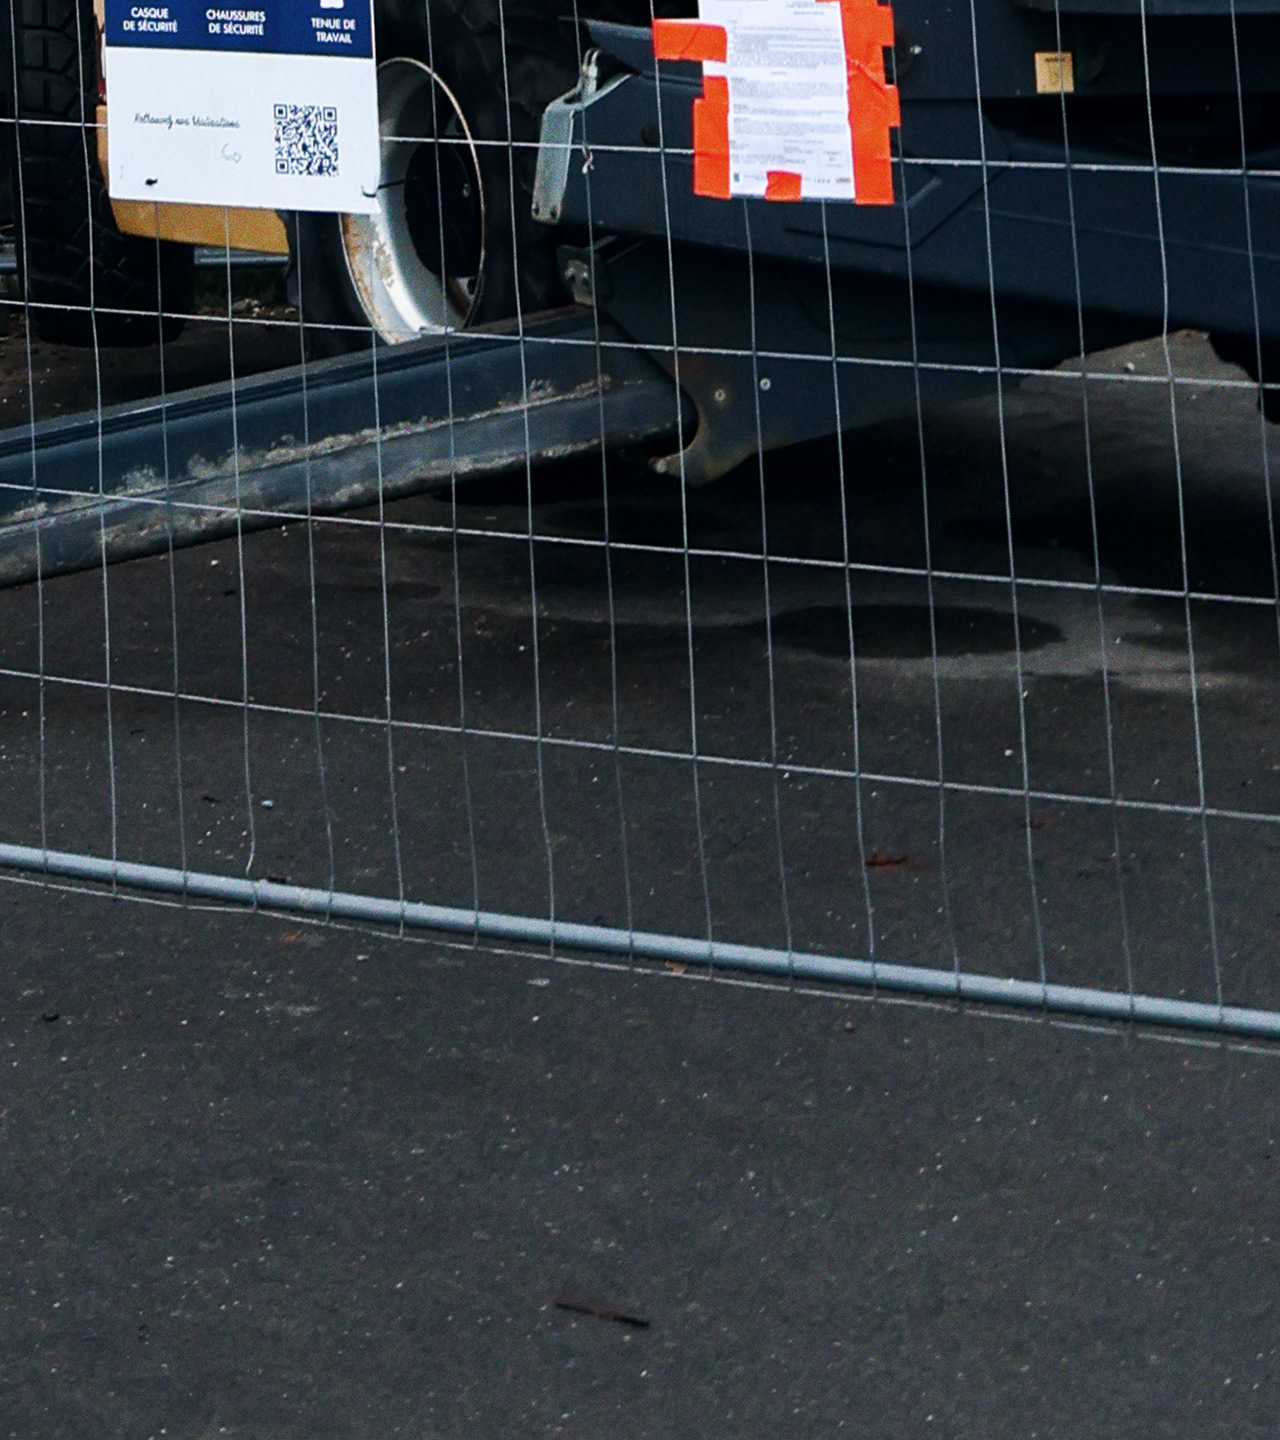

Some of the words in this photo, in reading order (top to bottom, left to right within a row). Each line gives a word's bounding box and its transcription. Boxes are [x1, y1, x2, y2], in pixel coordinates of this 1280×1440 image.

[131, 7, 169, 20] CASQUE
[206, 9, 266, 22] CHAUSSURES
[123, 20, 135, 32] DE
[137, 18, 178, 33] SÉCURITÉ
[208, 22, 221, 34] DE
[223, 21, 264, 36] SÉCURITÉ
[311, 17, 340, 30] TENUE
[343, 19, 356, 30] DE
[316, 31, 352, 44] TRAVAIL
